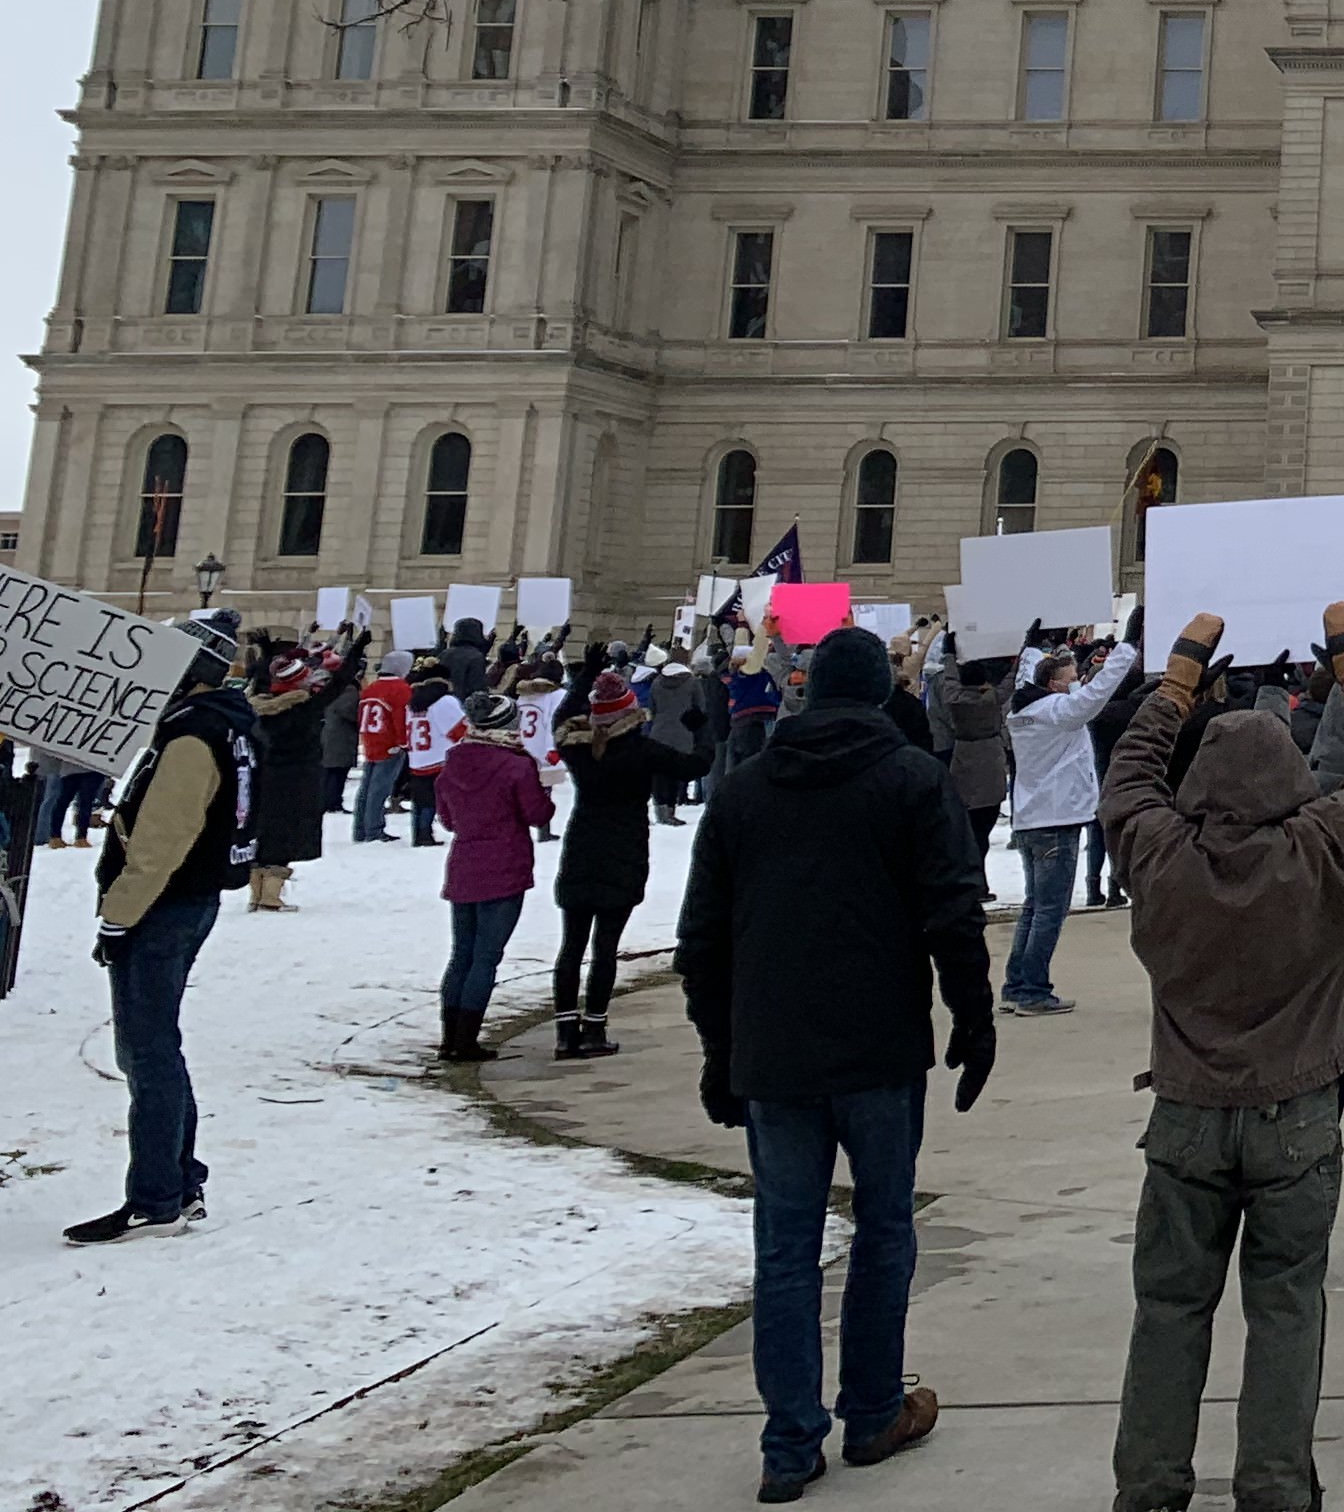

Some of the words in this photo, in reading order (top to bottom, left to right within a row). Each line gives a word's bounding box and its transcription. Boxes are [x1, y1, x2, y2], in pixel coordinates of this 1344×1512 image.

[0, 573, 80, 648] ERE
[77, 609, 154, 670] IS
[7, 651, 170, 726] SCIENCE
[0, 682, 140, 763] EGATIVE!
[359, 703, 385, 733] 13
[407, 719, 432, 752] 13
[519, 710, 538, 738] 3
